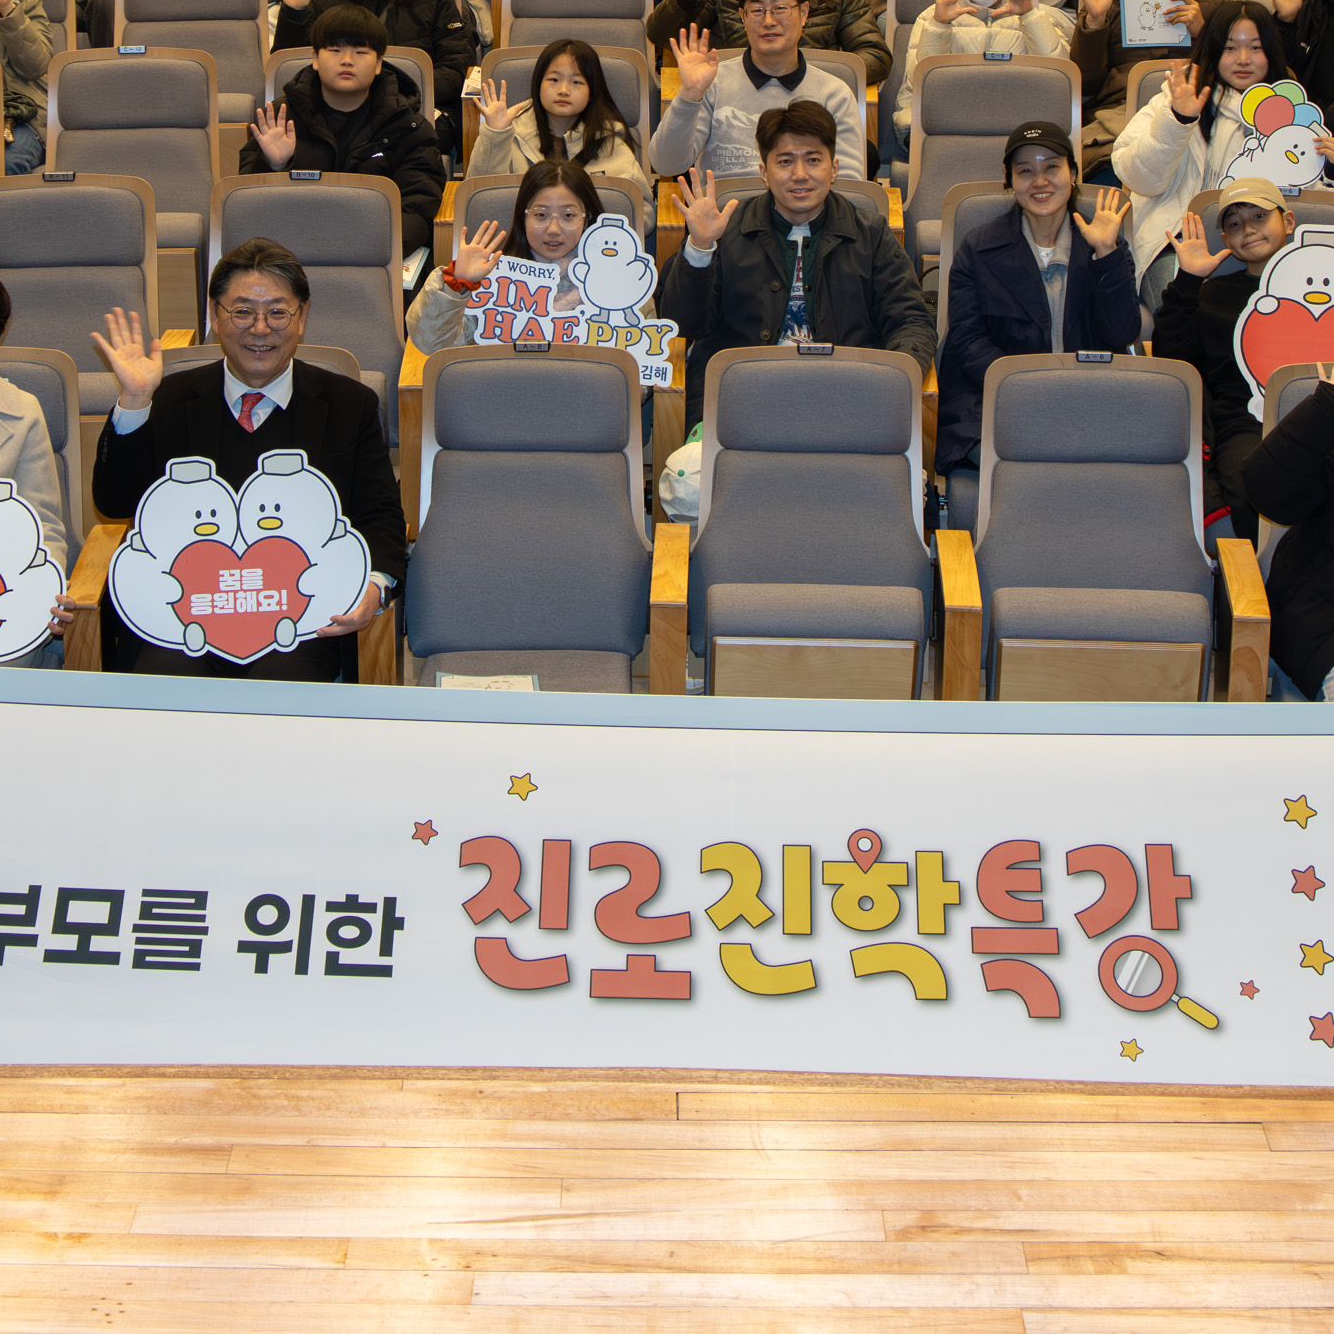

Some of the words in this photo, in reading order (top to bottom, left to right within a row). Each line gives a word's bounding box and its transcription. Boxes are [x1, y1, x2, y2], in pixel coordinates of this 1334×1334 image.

[507, 260, 556, 280] WORRY,
[218, 568, 264, 591] 꿈을
[190, 589, 289, 615] 응원해요!
[236, 892, 406, 978] 위한
